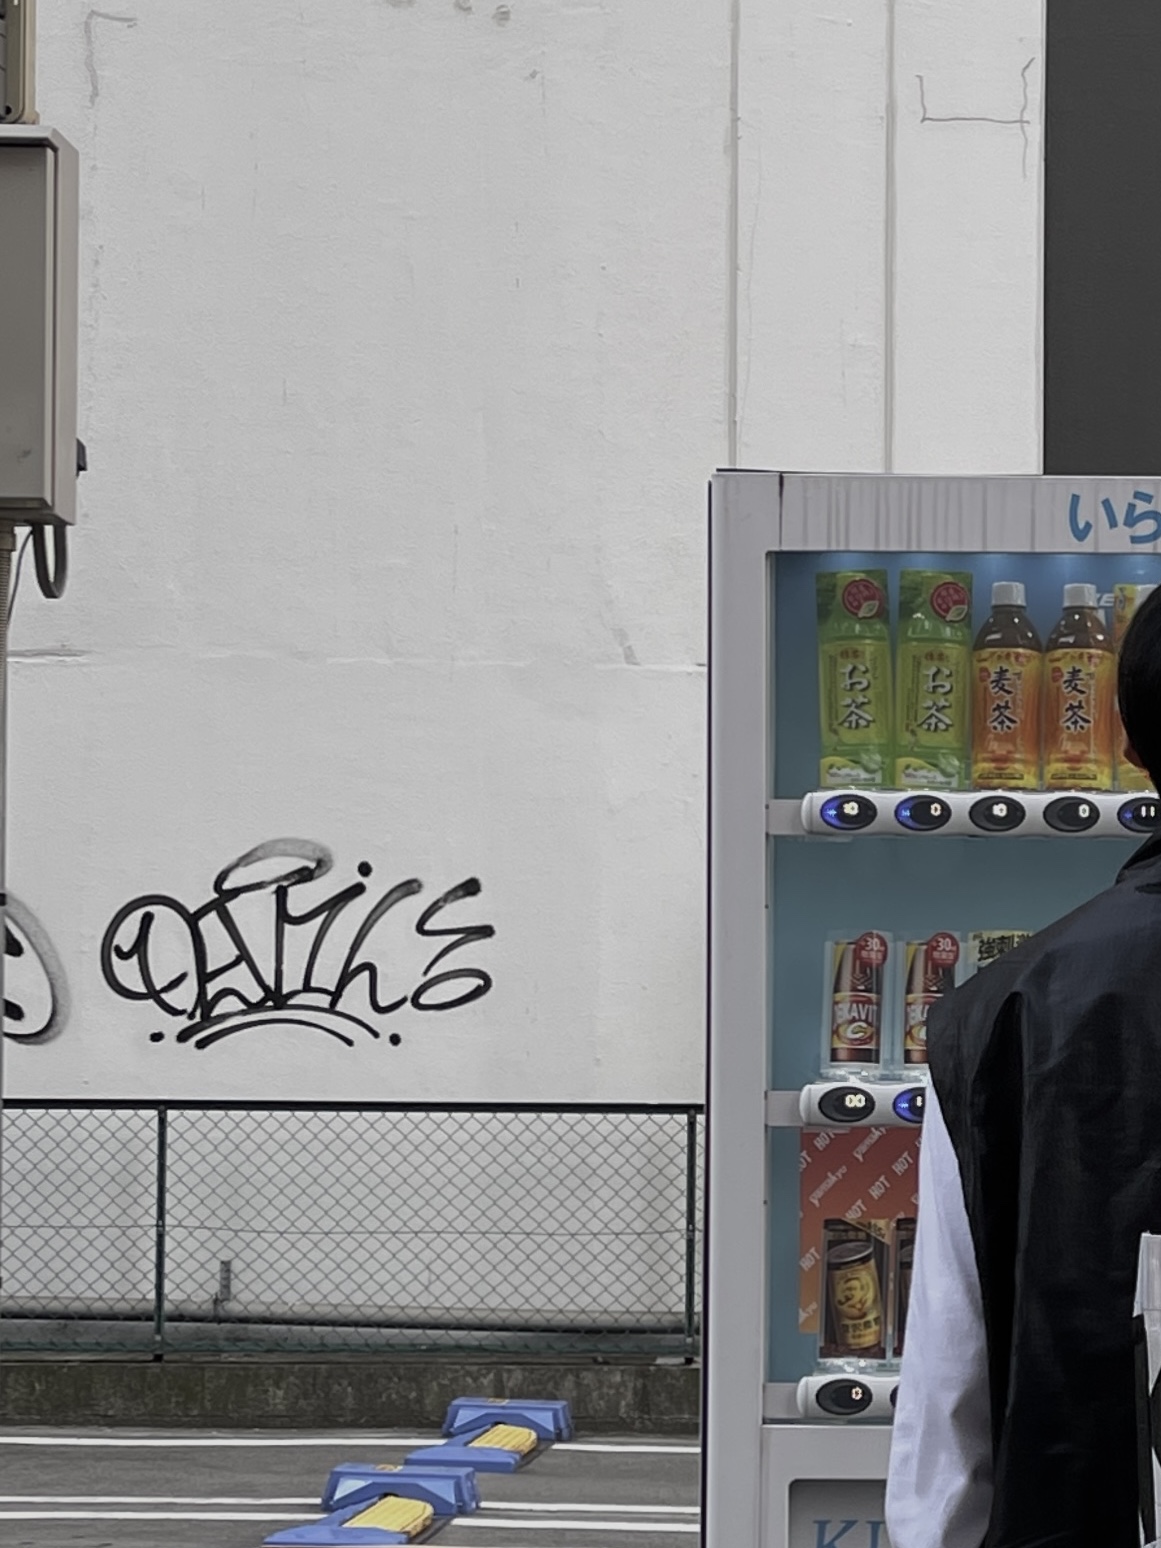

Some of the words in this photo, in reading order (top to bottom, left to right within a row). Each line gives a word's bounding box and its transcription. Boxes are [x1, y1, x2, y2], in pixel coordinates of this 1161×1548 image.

[837, 663, 876, 730] お茶
[917, 665, 954, 732] お茶
[988, 664, 1018, 733] 麦茶
[1062, 664, 1092, 733] 麦茶
[868, 1175, 890, 1200] HOT
[891, 1151, 913, 1176] HOT
[799, 1247, 820, 1271] HOT
